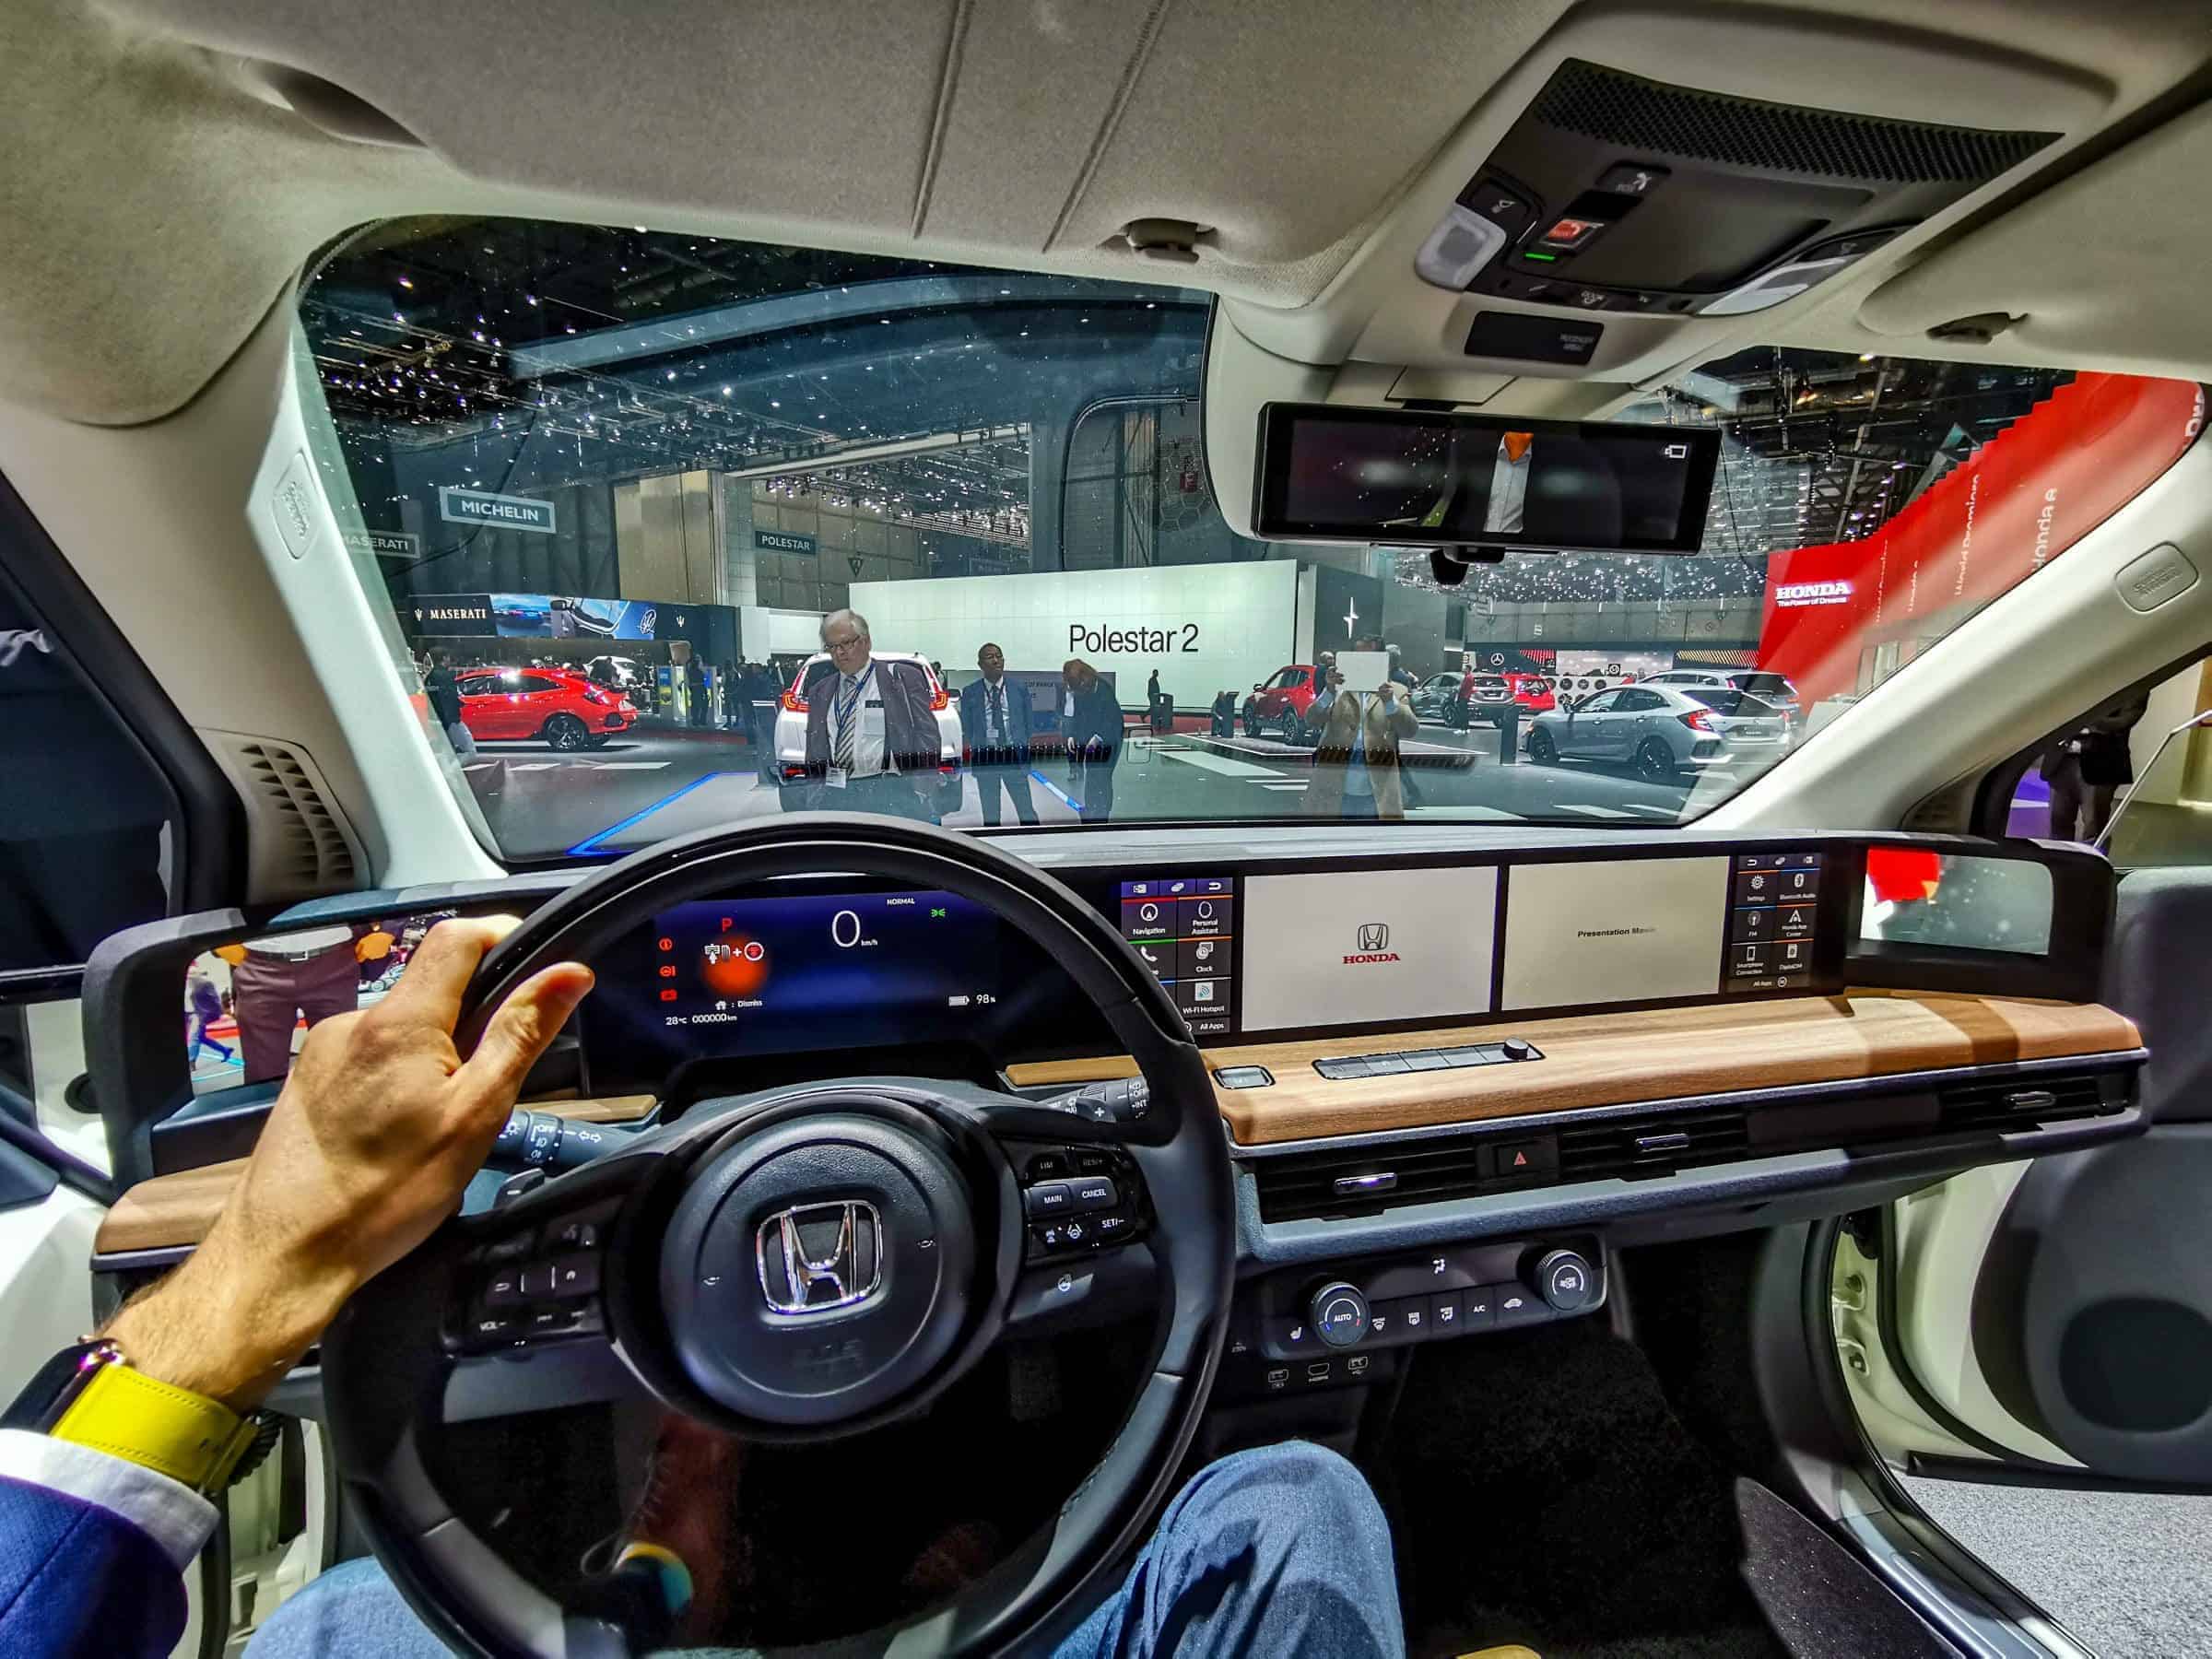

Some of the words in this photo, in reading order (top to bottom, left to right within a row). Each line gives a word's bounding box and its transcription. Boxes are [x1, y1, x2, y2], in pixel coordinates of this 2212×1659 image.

[461, 500, 539, 522] MICHELIN
[761, 535, 811, 551] POLESTAR
[1775, 581, 1852, 600] HONDA
[429, 608, 488, 619] MASERATI
[1069, 624, 1178, 653] Polestar
[1181, 623, 1199, 653] 2
[722, 918, 733, 932] P
[832, 910, 861, 947] 0
[1133, 927, 1166, 935] Navigation
[1578, 928, 1630, 937] Presentation
[1343, 953, 1401, 964] HONDA
[1043, 1194, 1063, 1204] MAIN
[1082, 1188, 1107, 1199] CANCEL
[1473, 1304, 1486, 1312] A/C
[1334, 1313, 1352, 1322] AUTO
